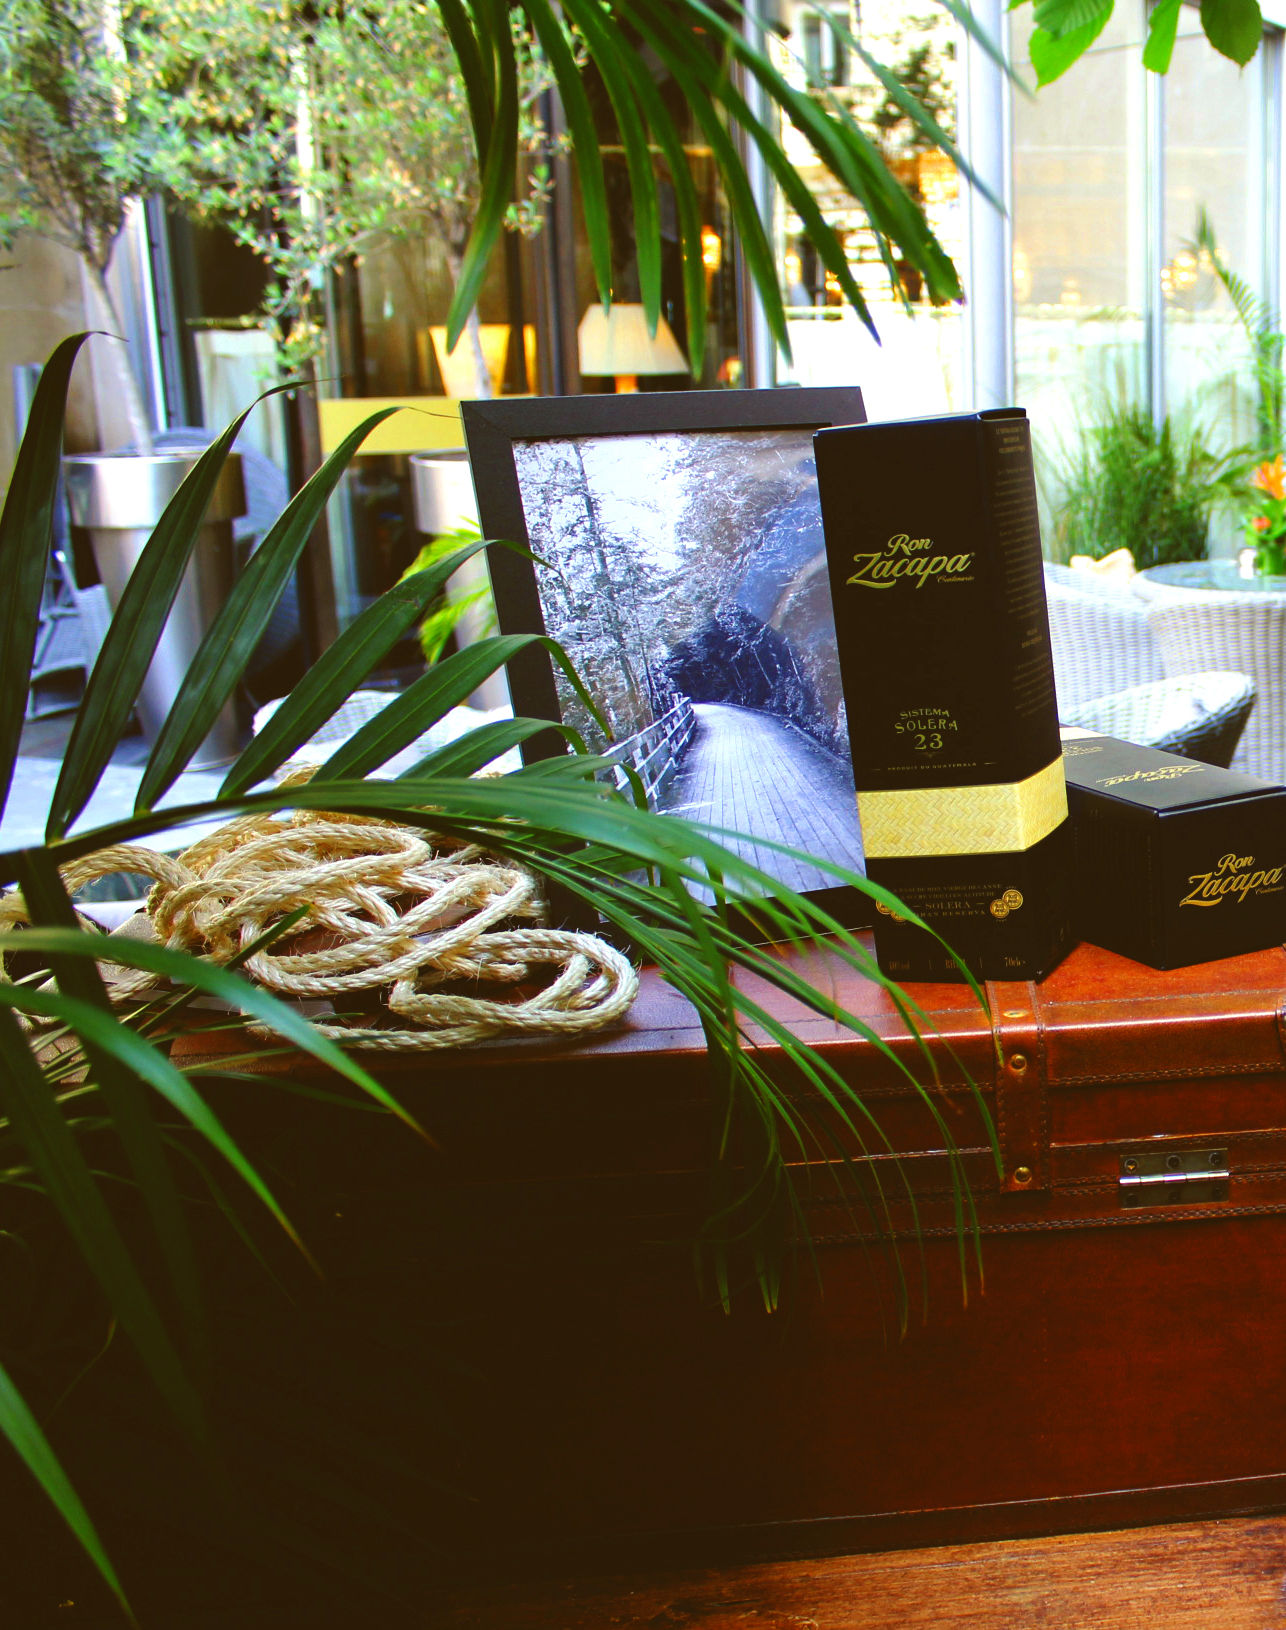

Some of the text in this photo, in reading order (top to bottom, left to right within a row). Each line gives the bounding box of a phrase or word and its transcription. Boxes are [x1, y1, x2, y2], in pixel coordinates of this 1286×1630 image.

[884, 533, 934, 557] Ron
[845, 551, 972, 589] Zacapa
[899, 708, 950, 720] SISTEMA
[894, 718, 959, 734] SOLERA
[914, 732, 944, 750] 23
[1213, 853, 1256, 876] Ron
[1178, 866, 1285, 907] Zacapa
[925, 901, 971, 910] SOLERA
